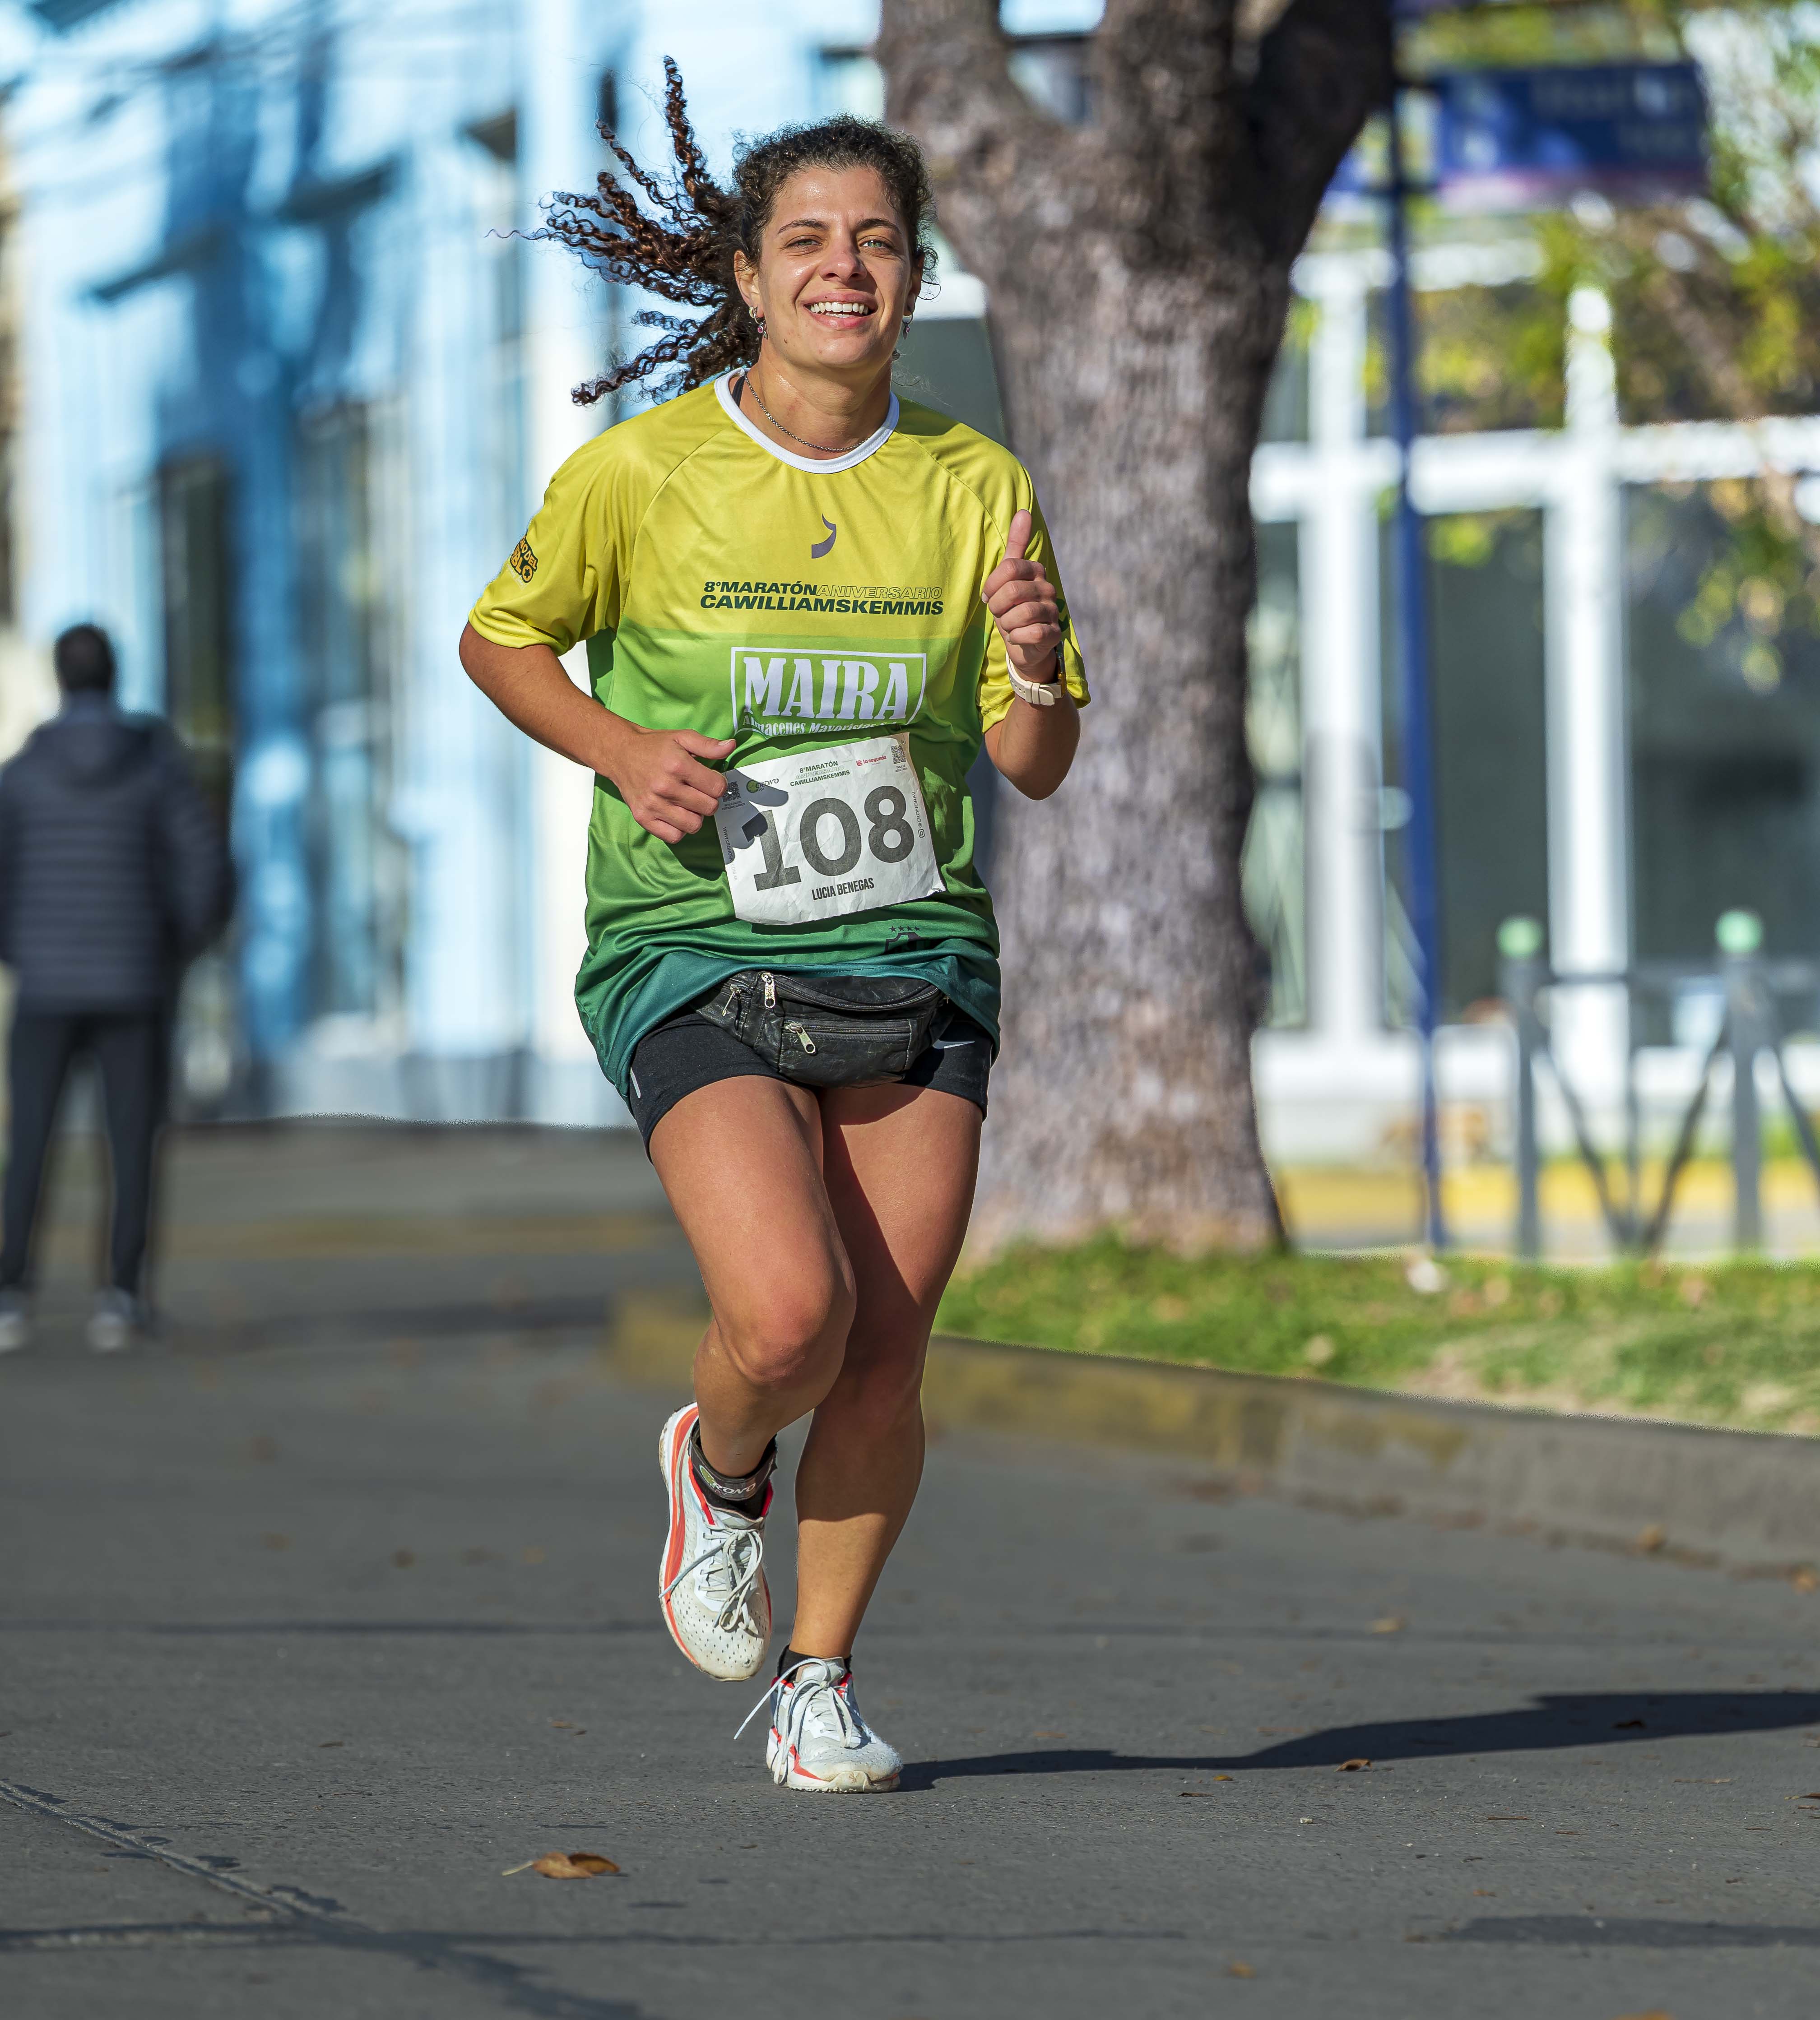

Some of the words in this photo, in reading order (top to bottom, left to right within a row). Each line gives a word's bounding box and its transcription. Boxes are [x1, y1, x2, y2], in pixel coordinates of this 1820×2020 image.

[524, 550, 537, 570] DEL
[700, 594, 944, 615] CAWILLIAMSKEMMIS
[743, 657, 910, 720] MAIRA
[743, 715, 806, 736] Almacenes
[790, 770, 850, 786] CAWILLIAMSKEMMIS
[911, 791, 922, 828] @CRONORAV
[741, 785, 915, 891] 108
[812, 885, 836, 900] LUCIA
[836, 877, 874, 895] BENEGAS
